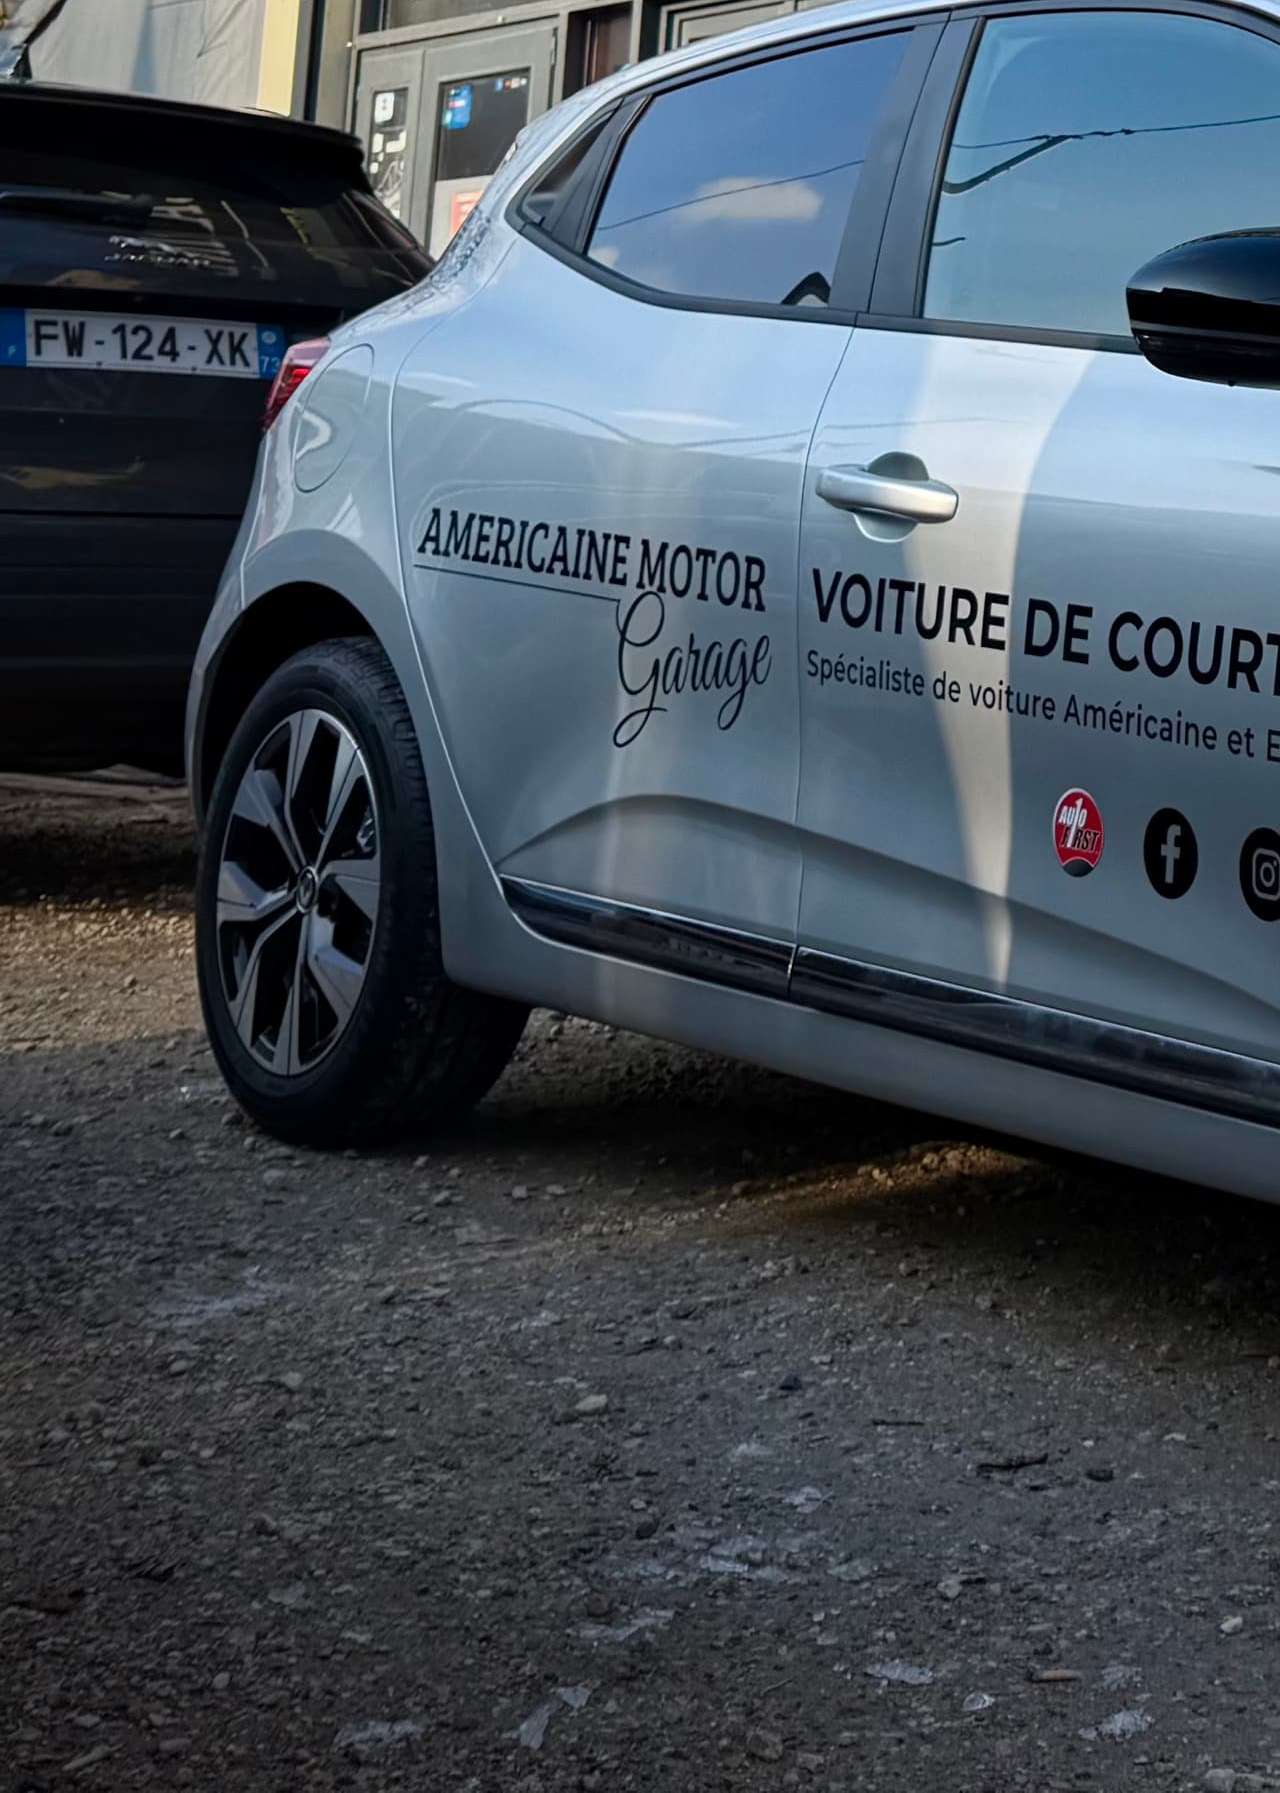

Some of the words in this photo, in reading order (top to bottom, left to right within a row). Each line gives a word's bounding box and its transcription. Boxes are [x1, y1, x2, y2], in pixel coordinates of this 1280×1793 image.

[417, 508, 630, 586] AMERICAINE
[635, 539, 767, 612] MOTOR
[613, 591, 772, 748] Garage
[811, 568, 1010, 651] VOITURE
[1024, 598, 1093, 665] DE
[807, 649, 925, 697] Spécialiste
[932, 669, 961, 703] de
[969, 682, 1056, 721] voiture
[1063, 694, 1217, 752] Américaine
[1227, 727, 1255, 759] et
